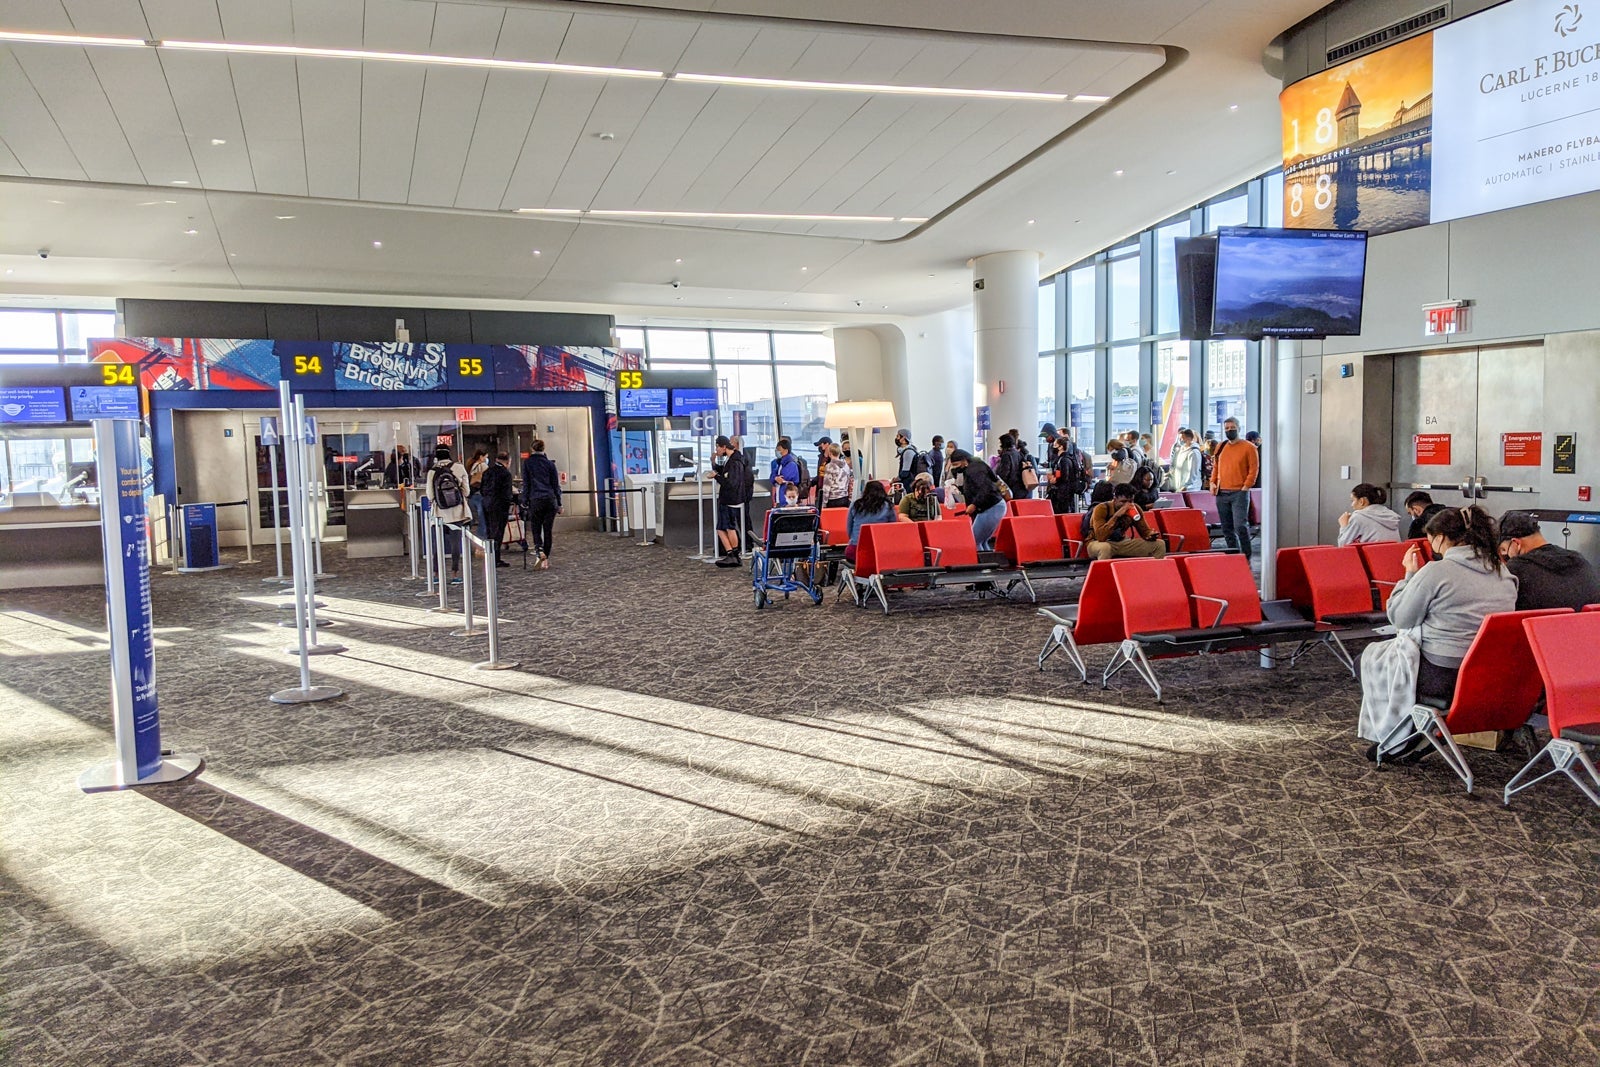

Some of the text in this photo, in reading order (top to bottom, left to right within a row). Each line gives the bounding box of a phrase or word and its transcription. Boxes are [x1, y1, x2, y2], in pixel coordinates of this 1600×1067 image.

[1480, 66, 1531, 94] CARL
[1534, 56, 1548, 79] F.
[1520, 77, 1579, 103] LUCERNE
[1299, 161, 1309, 171] OF
[1311, 147, 1351, 166] LUCERNE
[1518, 144, 1563, 162] MANERO
[1485, 164, 1543, 186] AUTOMATIC
[294, 356, 322, 373] 54
[349, 343, 428, 381] Brooklyn
[459, 358, 482, 375] 55
[103, 365, 135, 385] 54
[344, 362, 404, 390] Bridge
[620, 371, 643, 389] 55
[458, 409, 475, 421] EXIT
[692, 416, 704, 432] C
[704, 415, 714, 430] C
[1425, 416, 1438, 425] BA
[263, 422, 277, 439] A
[304, 422, 314, 438] A
